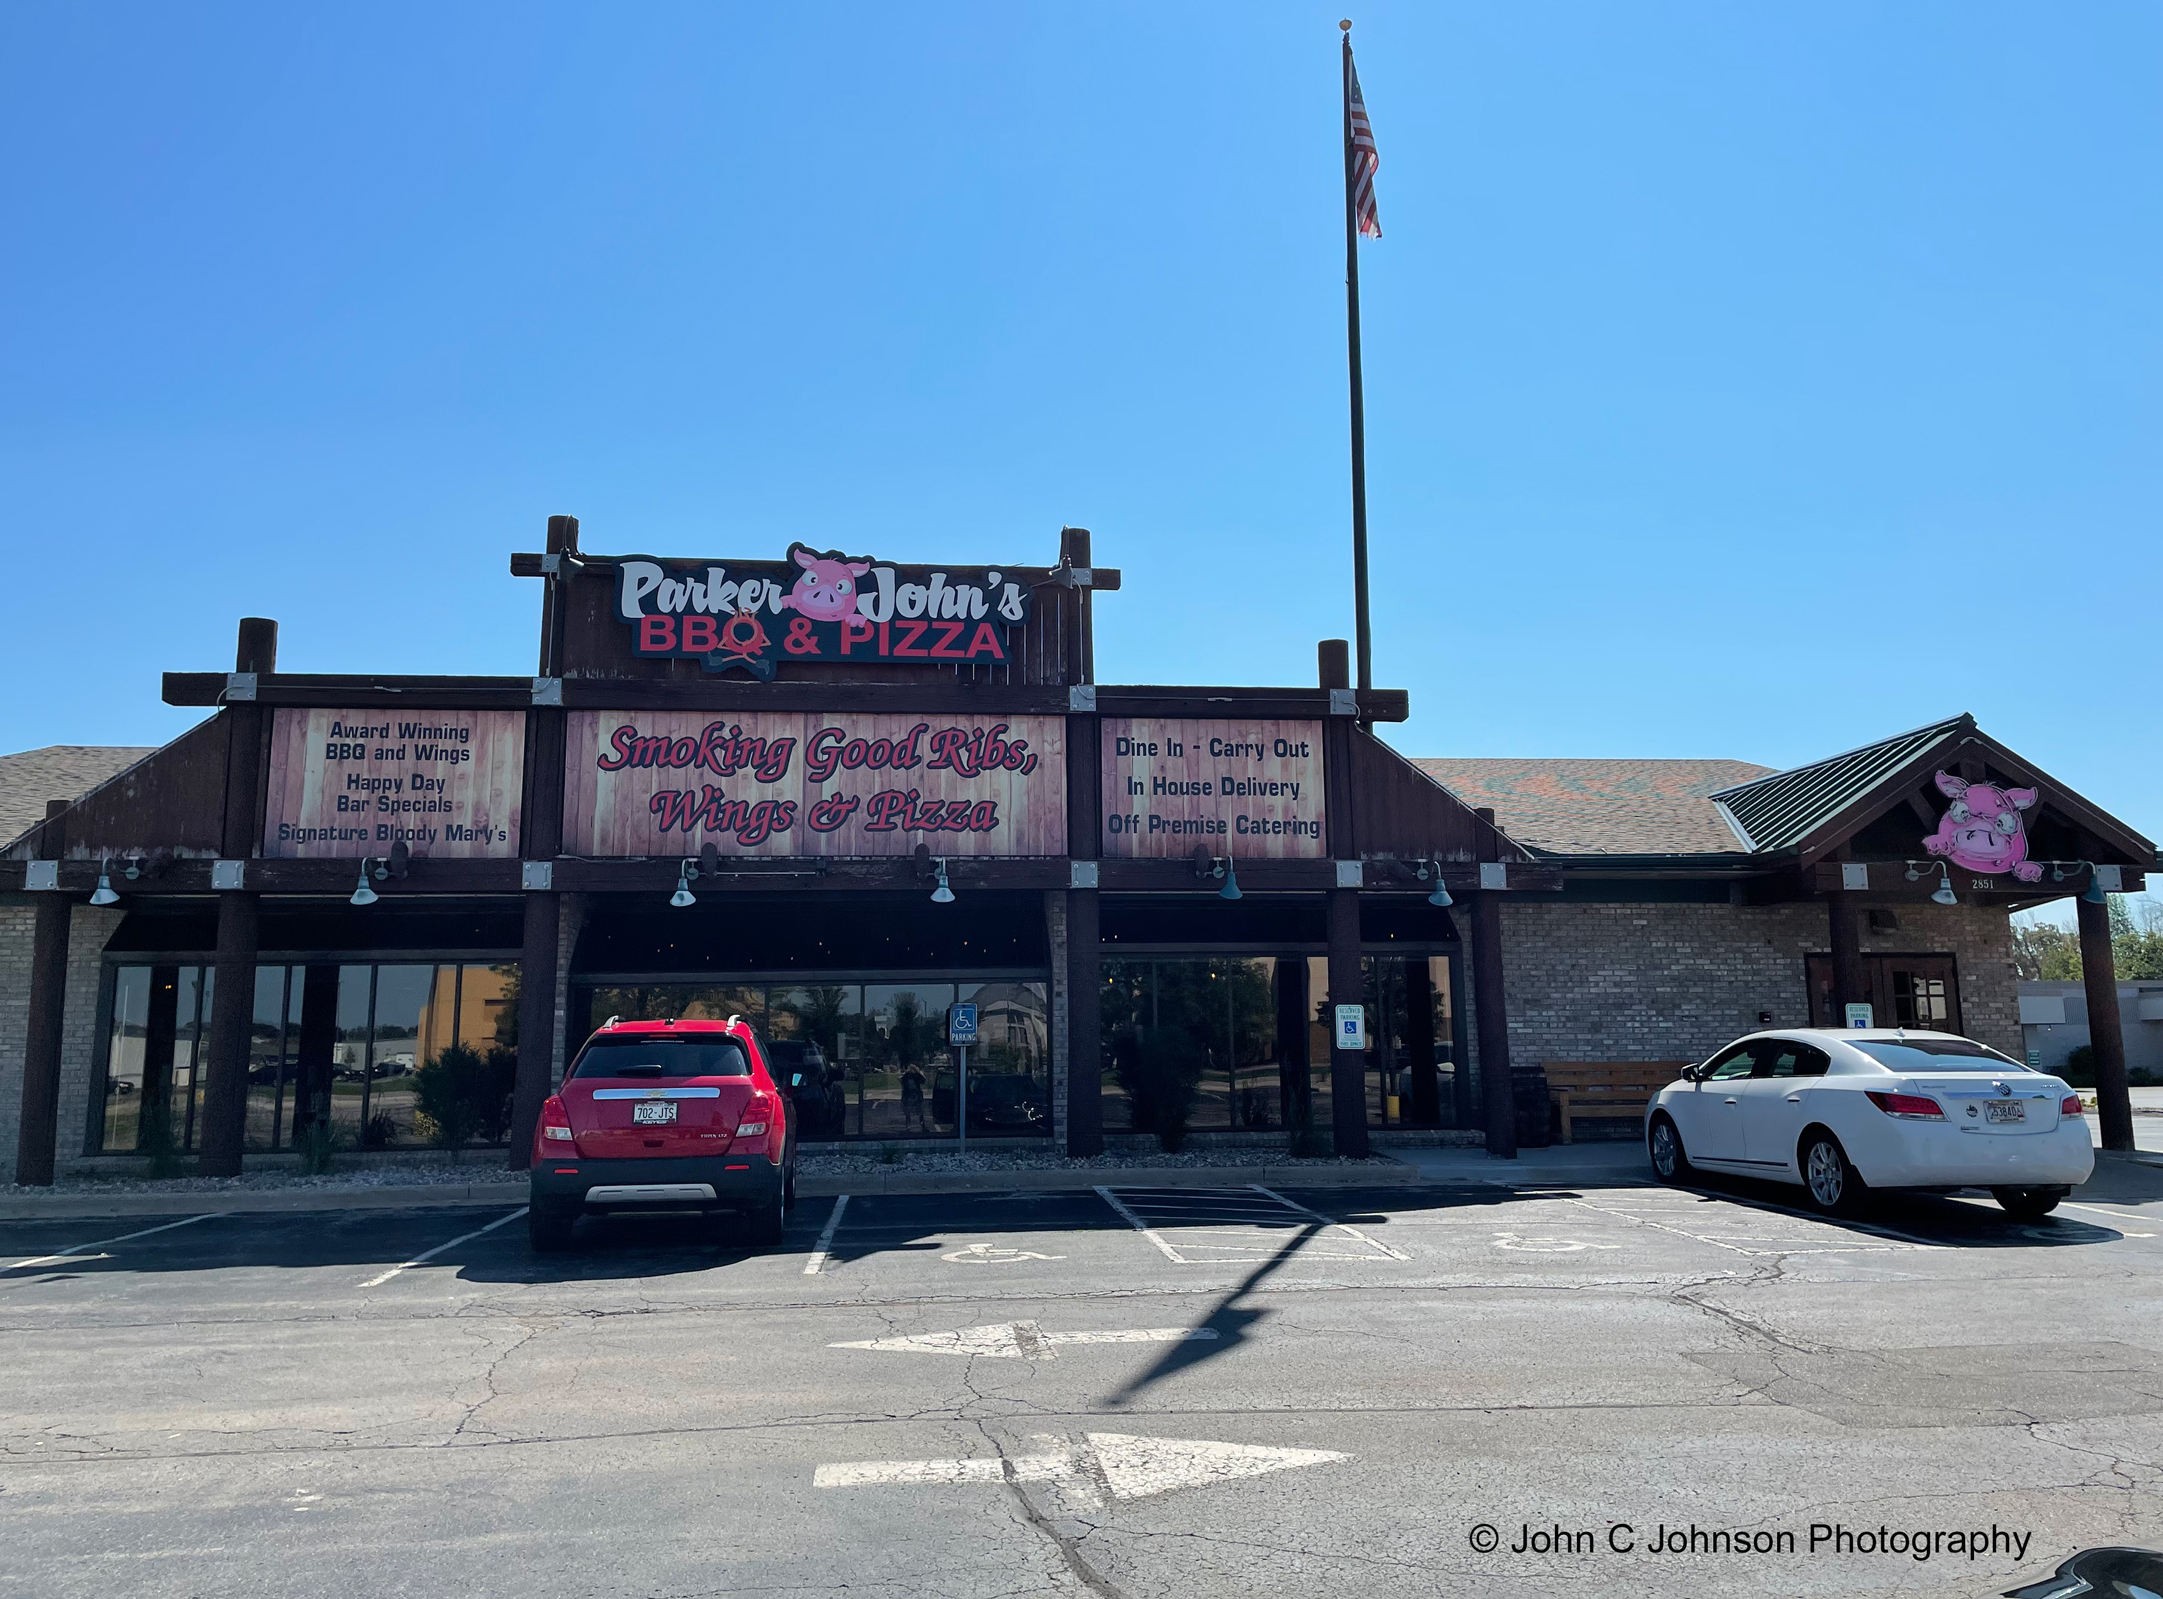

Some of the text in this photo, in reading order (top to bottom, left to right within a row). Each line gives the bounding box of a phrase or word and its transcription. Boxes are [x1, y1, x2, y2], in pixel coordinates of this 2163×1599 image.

[619, 561, 1028, 623] Parker John's
[639, 614, 1005, 659] BBQ & PIZZA
[330, 721, 470, 743] Award Winning
[325, 743, 470, 765] BBQ and Wings
[597, 720, 1038, 783] Smoking Good Ribs,
[1116, 737, 1158, 757] Dine
[1167, 738, 1184, 757] In
[1209, 738, 1265, 762] Carry
[1273, 738, 1310, 758] Out
[346, 773, 446, 794] Happy Day
[1127, 776, 1301, 801] In House Delivery
[337, 795, 453, 816] Bar Specials
[649, 783, 1000, 847] Wings & Pizza
[278, 823, 507, 845] Signature Bloody Mary's
[1108, 814, 1321, 839] Off Premise Catering
[1972, 879, 1993, 889] 2851
[951, 1033, 976, 1041] PARKING
[637, 1107, 674, 1119] 702-JTS
